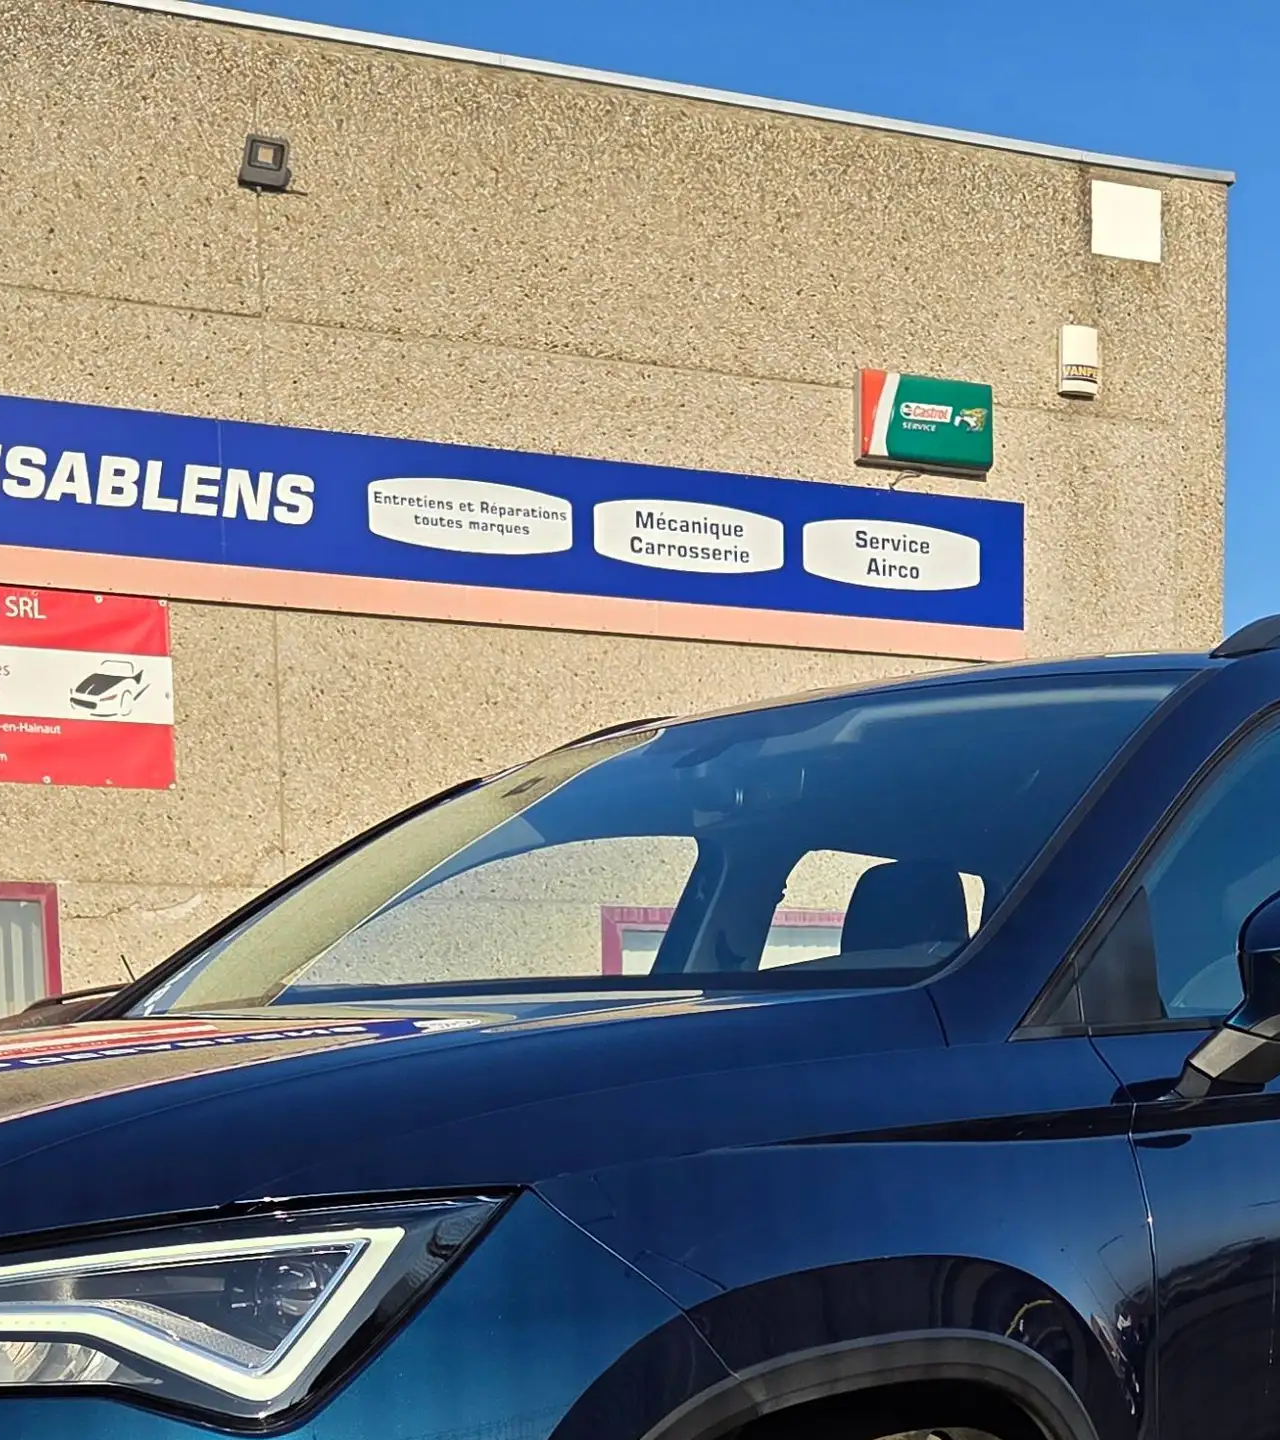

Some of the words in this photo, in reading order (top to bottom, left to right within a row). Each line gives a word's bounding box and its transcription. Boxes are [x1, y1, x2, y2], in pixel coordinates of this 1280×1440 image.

[913, 405, 949, 420] Castrol
[902, 421, 936, 432] SERVICE
[374, 491, 454, 511] Entretiens
[459, 503, 475, 513] et
[480, 501, 567, 521] Réparations
[414, 514, 463, 529] toutes
[469, 521, 530, 536] marques
[635, 510, 744, 540] Mécanique
[630, 536, 750, 563] Carrosserie
[855, 530, 930, 554] Service
[867, 558, 920, 580] Airco
[5, 596, 47, 620] SRL
